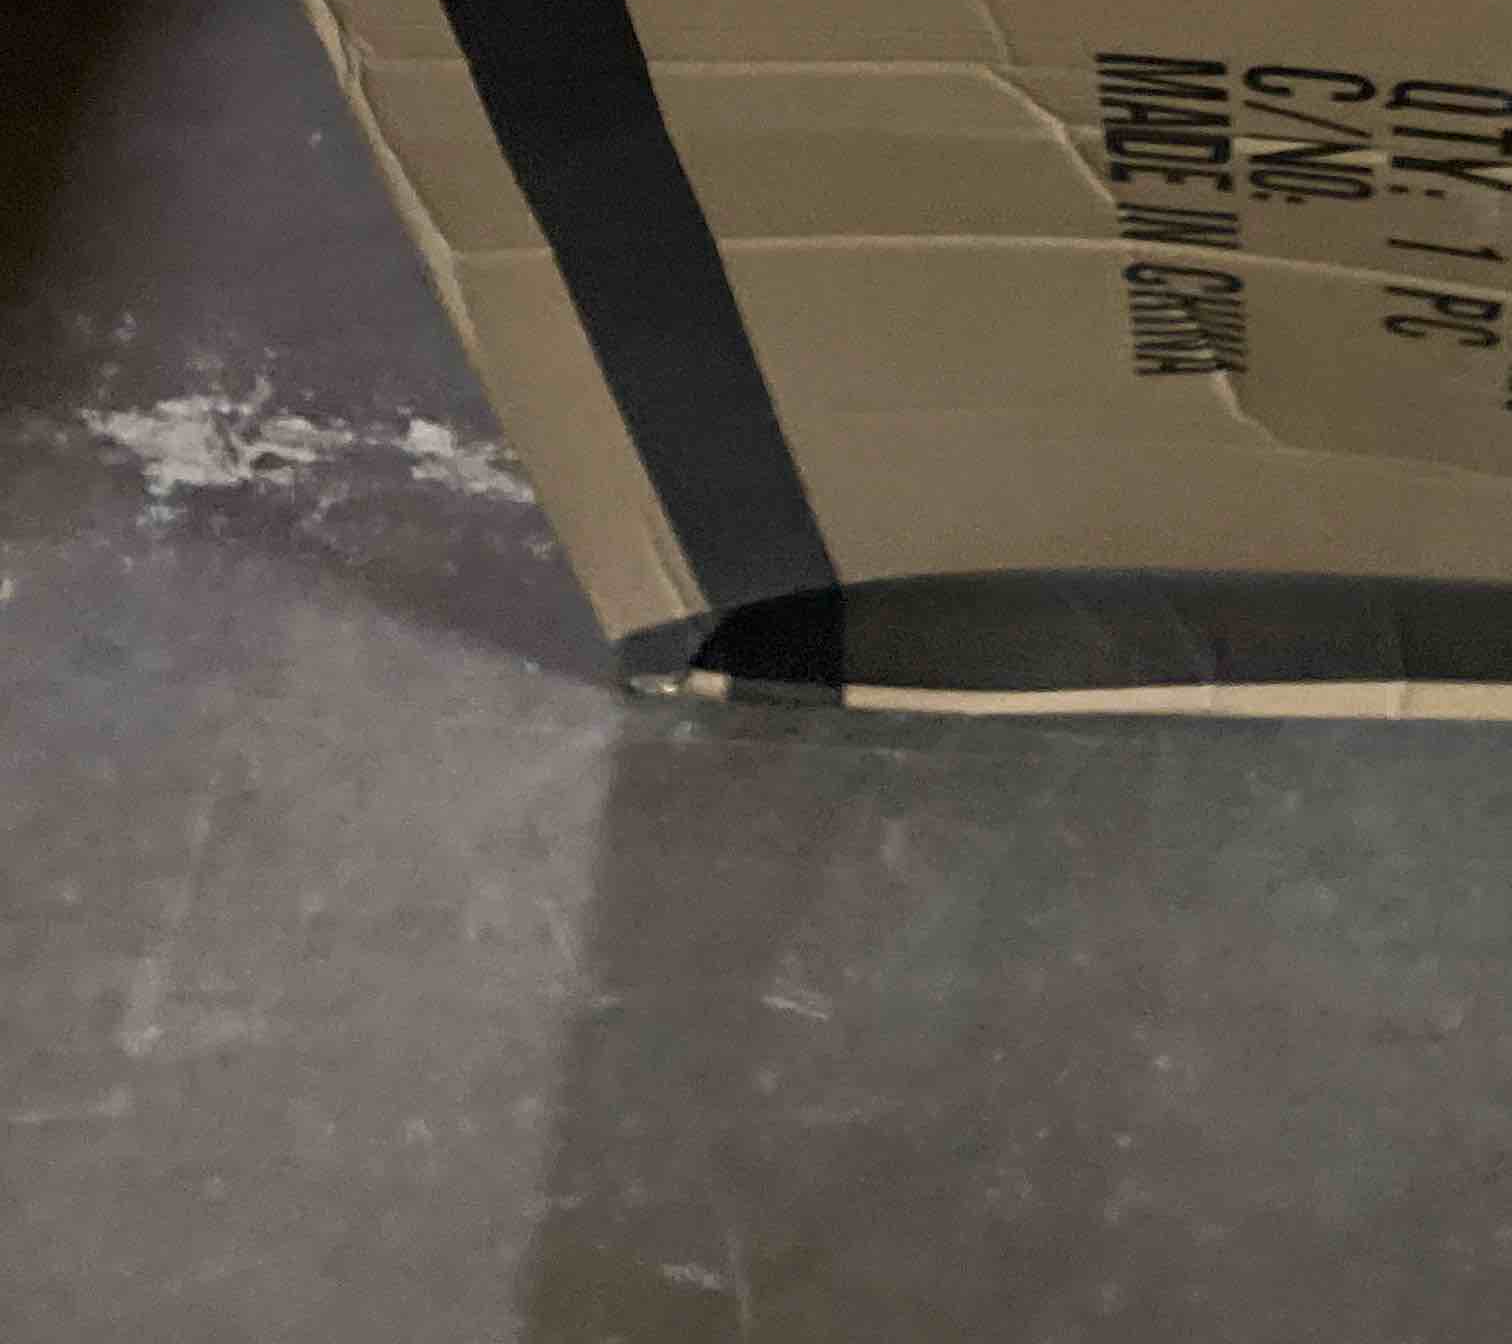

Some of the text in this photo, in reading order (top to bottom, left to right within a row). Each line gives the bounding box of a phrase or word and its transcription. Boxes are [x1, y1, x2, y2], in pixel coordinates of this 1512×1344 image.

[1244, 66, 1376, 205] C/NO:
[1096, 53, 1248, 376] MADE IN CHINA
[1387, 238, 1509, 263] 1
[1382, 286, 1504, 350] PC
